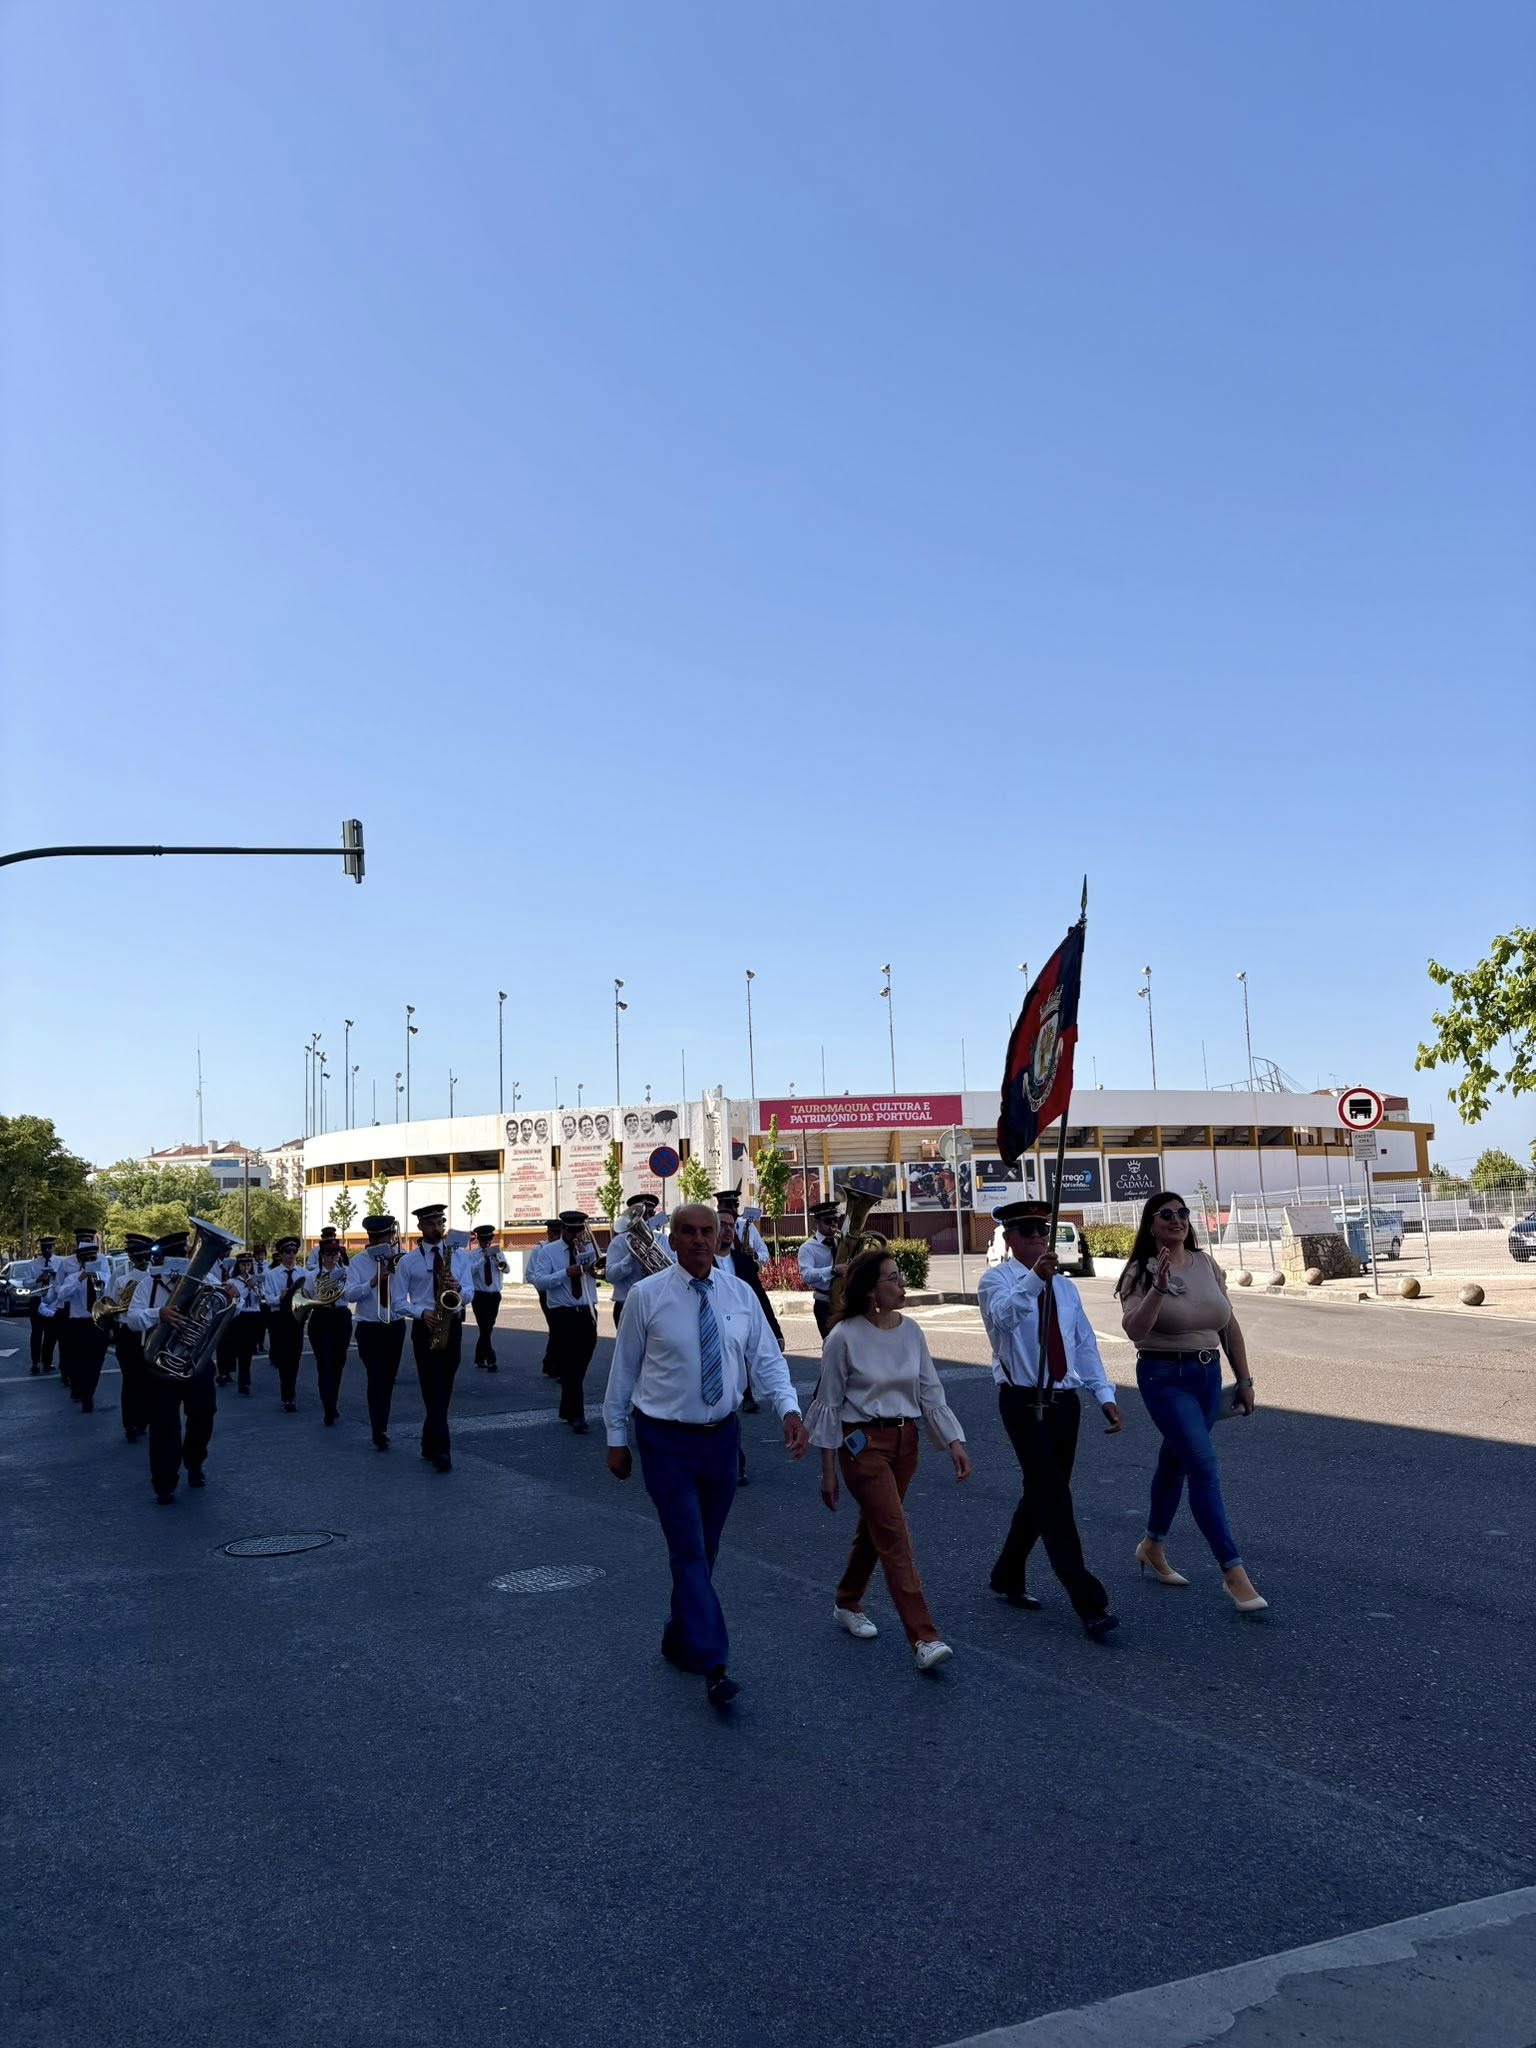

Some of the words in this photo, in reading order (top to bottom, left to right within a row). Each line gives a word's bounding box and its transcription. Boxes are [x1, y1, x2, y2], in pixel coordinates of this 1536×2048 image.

[791, 1104, 870, 1114] TAUROMAQUIA
[872, 1103, 921, 1112] CULTURA
[923, 1101, 931, 1111] E
[790, 1112, 858, 1124] PATRIMÓNIO
[860, 1113, 874, 1122] DE
[876, 1112, 933, 1121] PORTUGAL
[1120, 1173, 1149, 1181] CASA
[1116, 1180, 1155, 1189] CADAVAL
